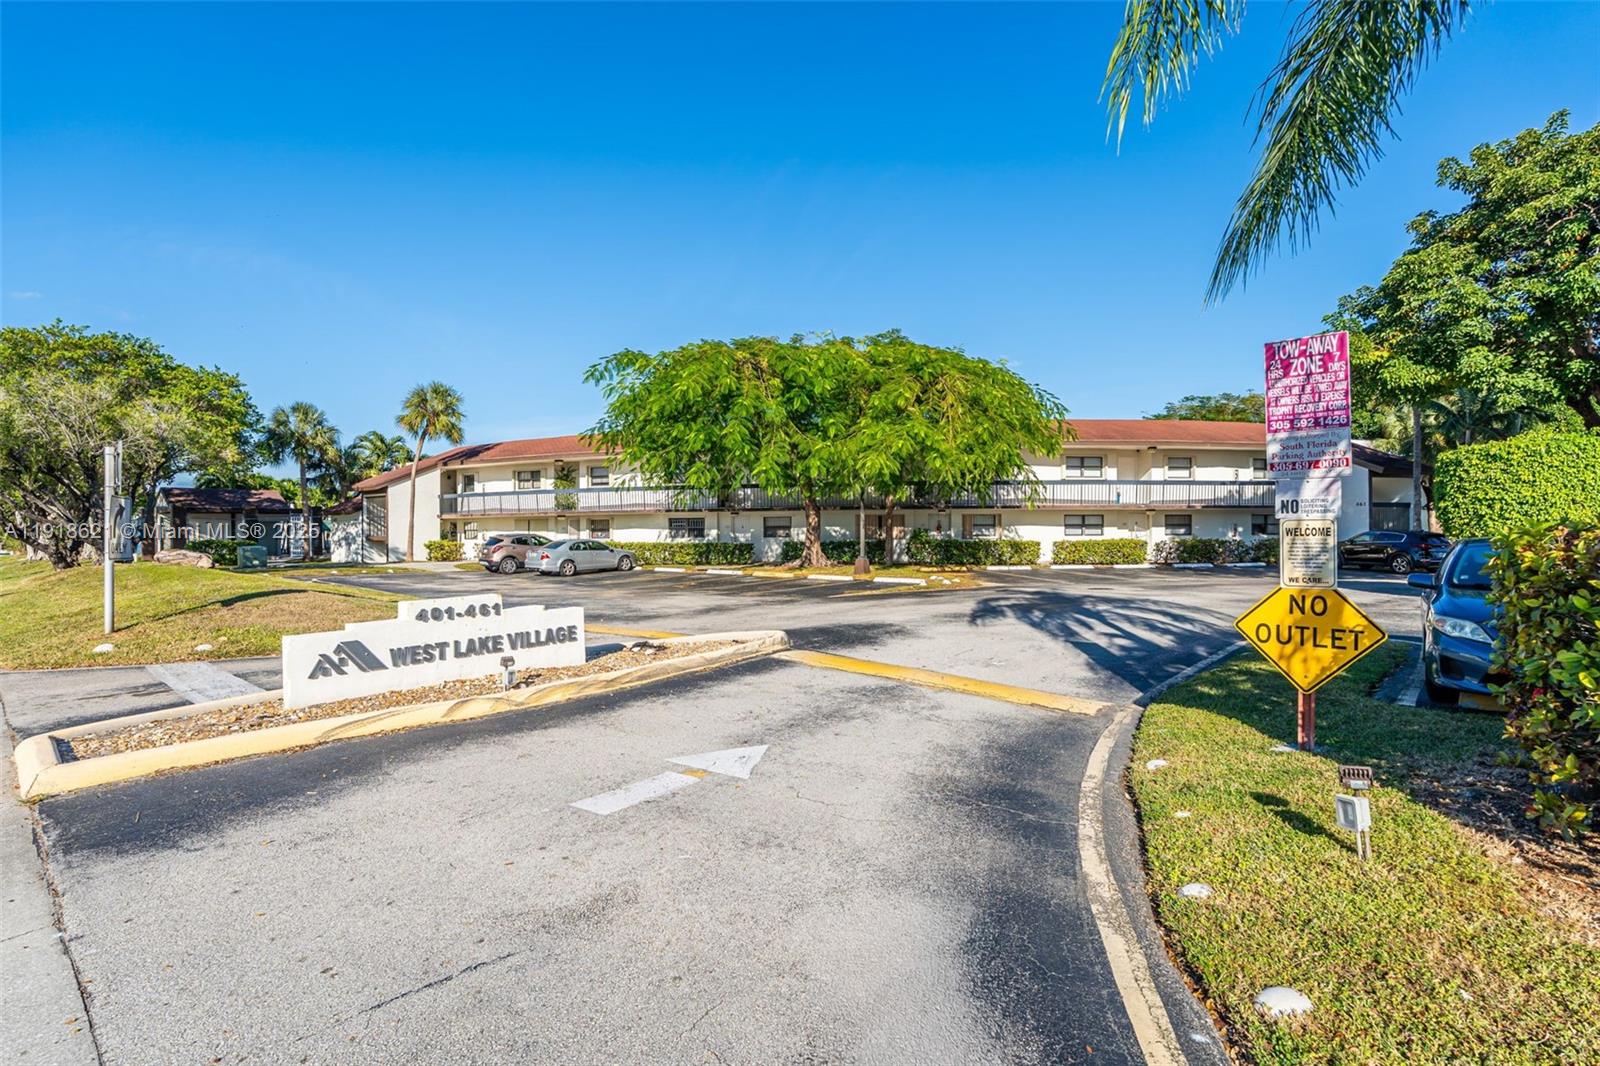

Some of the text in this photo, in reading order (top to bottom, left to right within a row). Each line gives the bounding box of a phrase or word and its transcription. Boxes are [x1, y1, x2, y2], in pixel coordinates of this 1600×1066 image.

[1272, 334, 1339, 360] TOW-AWAY
[1333, 352, 1340, 361] 7
[1270, 360, 1281, 370] 24
[1290, 355, 1324, 376] ZONE
[1328, 361, 1346, 372] DAYS
[1268, 369, 1284, 380] HRS
[1310, 373, 1335, 384] VEHICLES
[1337, 372, 1345, 380] OR
[1268, 388, 1290, 398] VESSELS
[1291, 386, 1302, 395] WILL
[1304, 384, 1312, 394] BE
[1314, 382, 1333, 392] TOWED
[1321, 390, 1346, 400] EXPENSE
[1268, 405, 1293, 416] TROPHY
[1295, 401, 1328, 413] RECOVERY
[1270, 421, 1290, 430] 305
[1294, 419, 1314, 428] 592
[1320, 415, 1347, 425] 1426
[1280, 440, 1337, 450] South Florida
[1272, 448, 1346, 461] Parking Authority
[1272, 458, 1346, 471] 305-697-0090
[1280, 499, 1299, 514] NO
[1285, 527, 1331, 536] WELCOME
[1289, 594, 1328, 616] NO
[415, 602, 502, 623] 401-461
[1255, 623, 1364, 651] OUTLET
[390, 625, 578, 667] WEST LAKE VILLAGE
